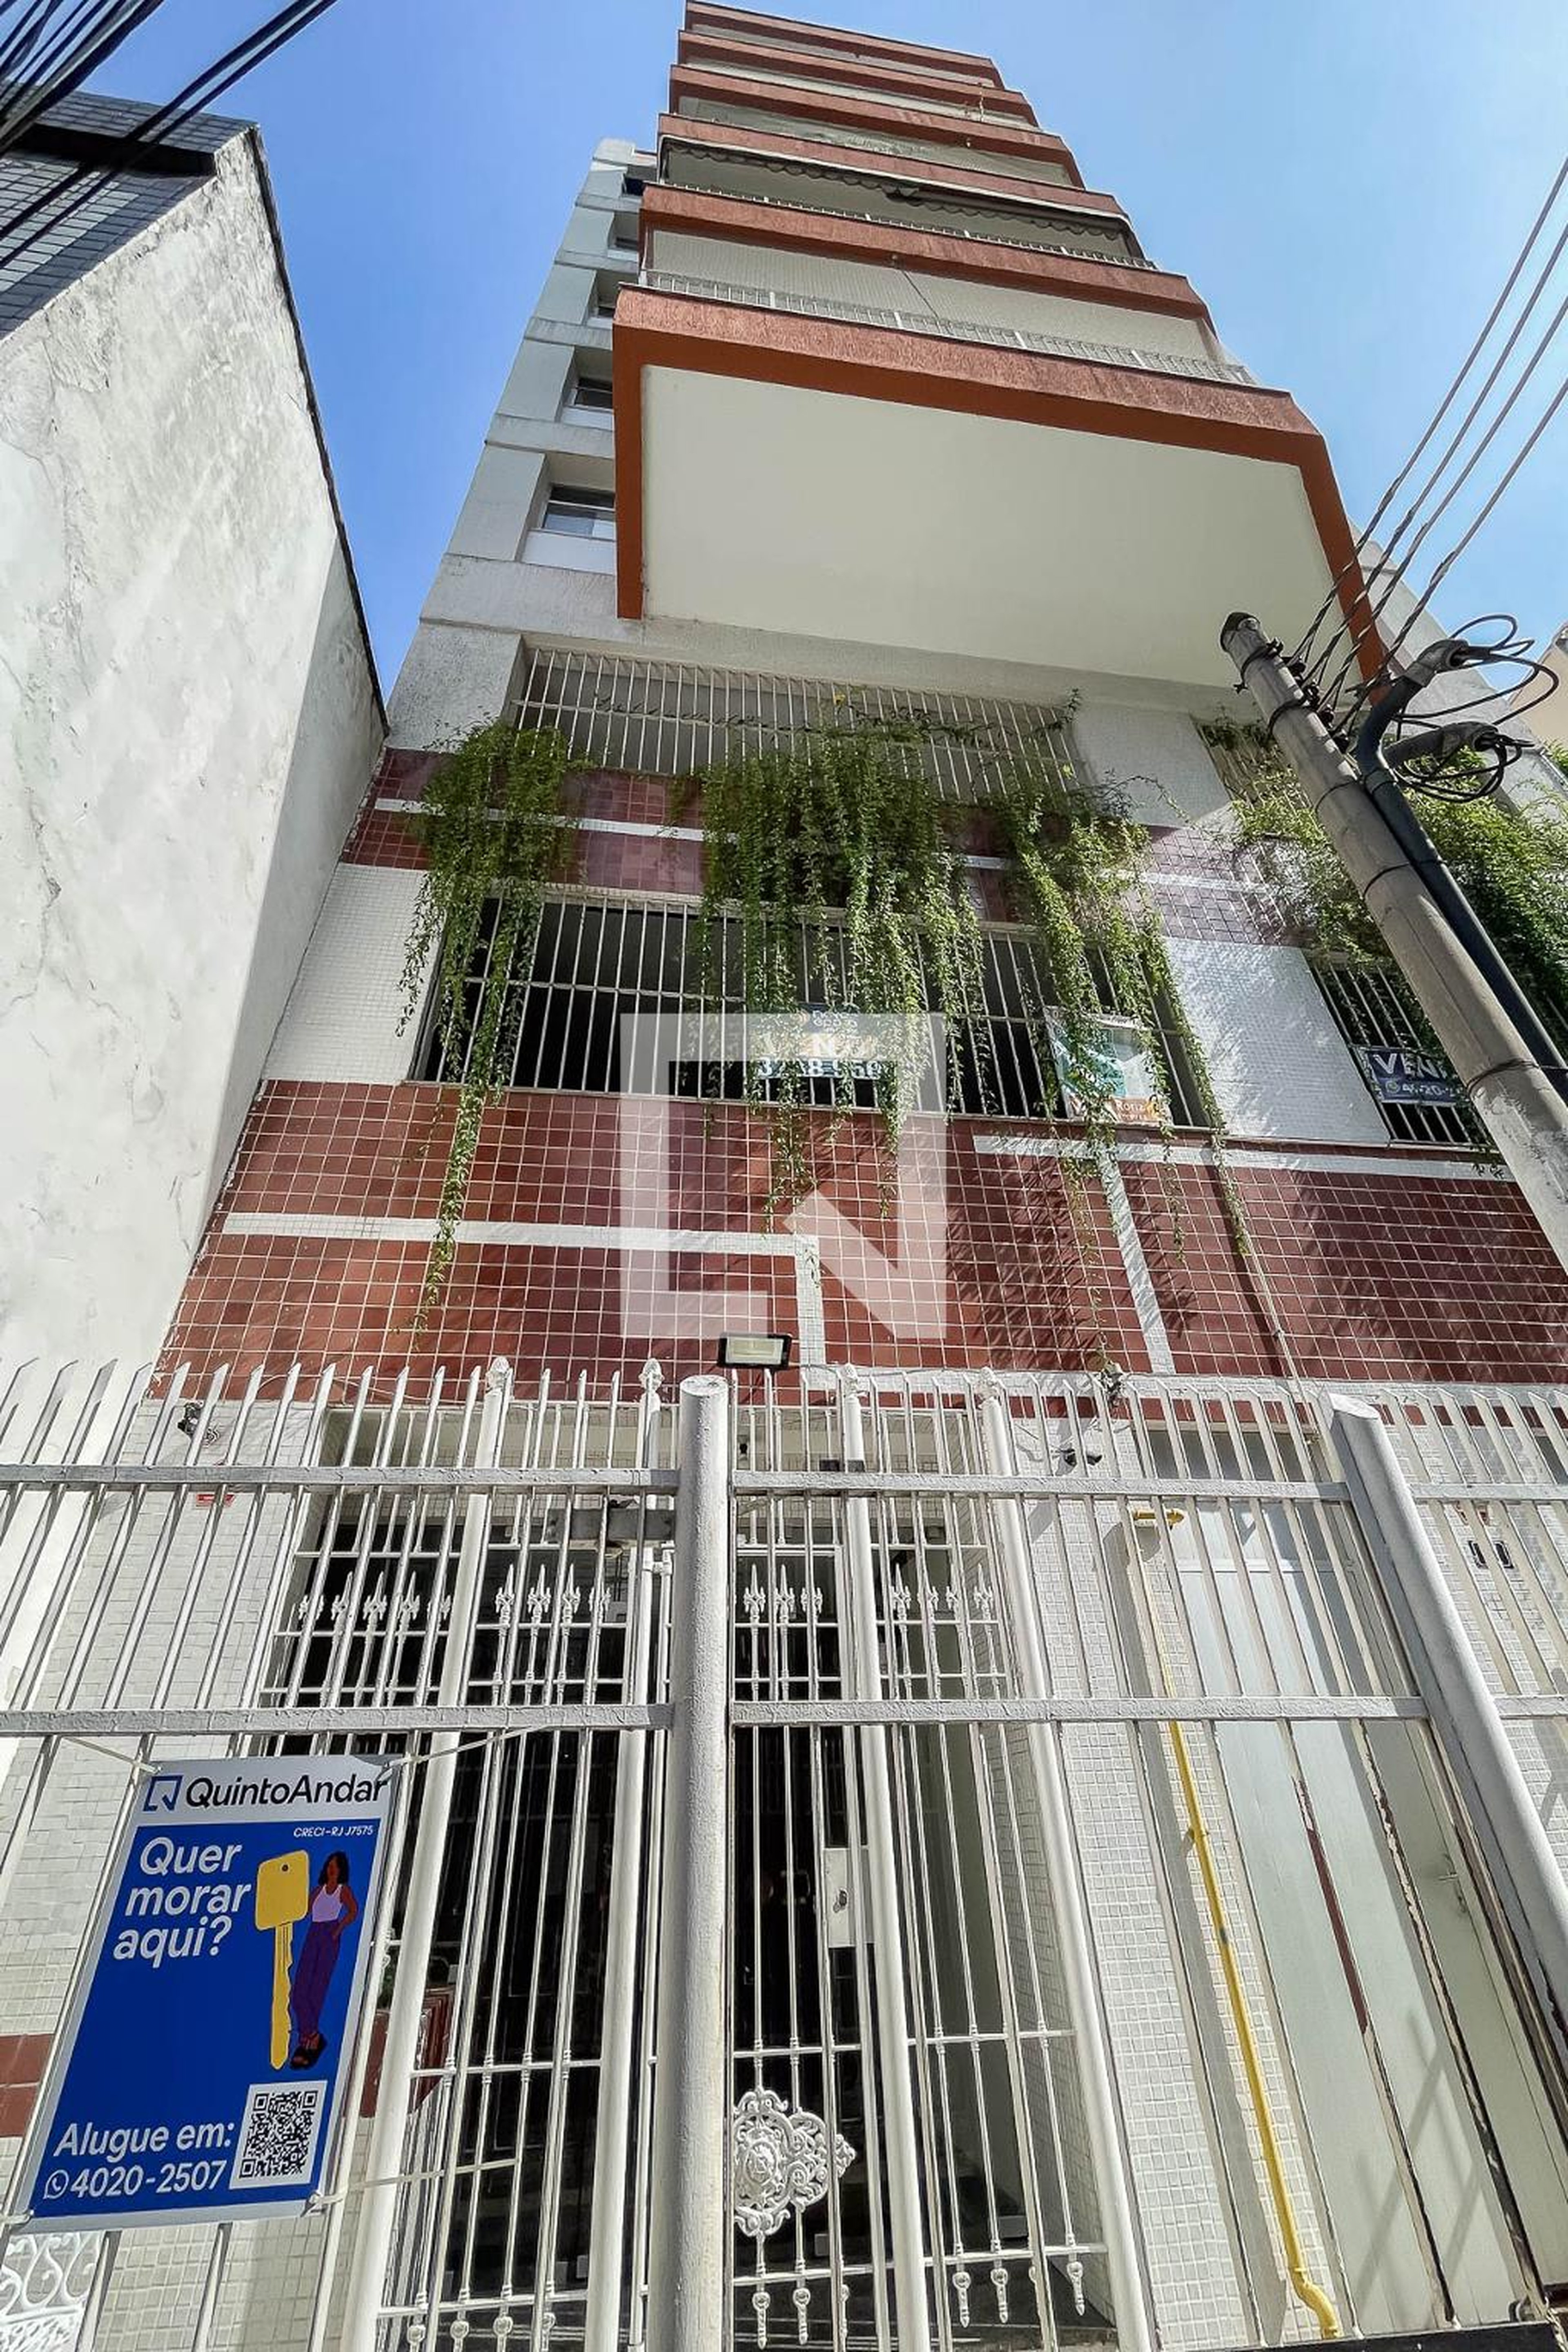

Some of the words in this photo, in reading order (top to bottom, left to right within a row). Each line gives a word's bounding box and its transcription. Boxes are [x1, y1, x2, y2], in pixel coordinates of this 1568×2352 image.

[186, 1774, 388, 1809] QuintoAndar
[293, 1826, 344, 1838] CRECI-RJ
[344, 1825, 373, 1836] J7575
[140, 1837, 243, 1876] Quer
[125, 1884, 252, 1916] morar
[113, 1915, 232, 1968] aqui?
[53, 2122, 169, 2163] Alugue
[176, 2123, 235, 2150] em:
[70, 2160, 227, 2198] 4020-2507
